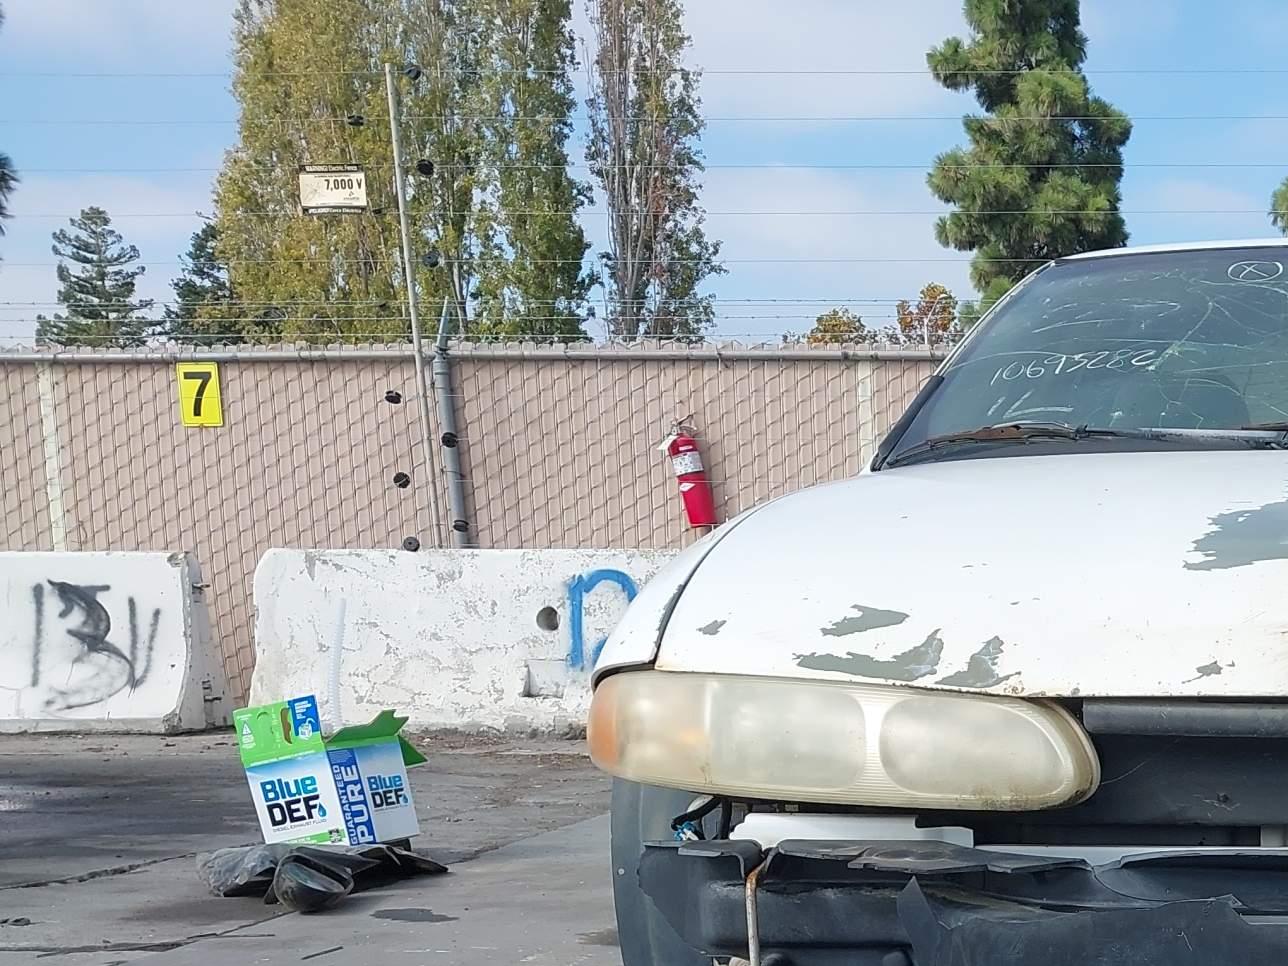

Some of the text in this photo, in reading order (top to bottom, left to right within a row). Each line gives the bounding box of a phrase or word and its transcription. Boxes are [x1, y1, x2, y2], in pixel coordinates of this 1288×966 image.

[324, 178, 362, 192] 7,000 V
[183, 371, 212, 417] 7
[260, 775, 318, 803] Blue
[367, 775, 403, 791] Blue
[371, 788, 404, 808] DEF
[266, 794, 320, 827] DEF
[332, 764, 358, 845] GUARANTEED
[340, 764, 374, 843] PURE
